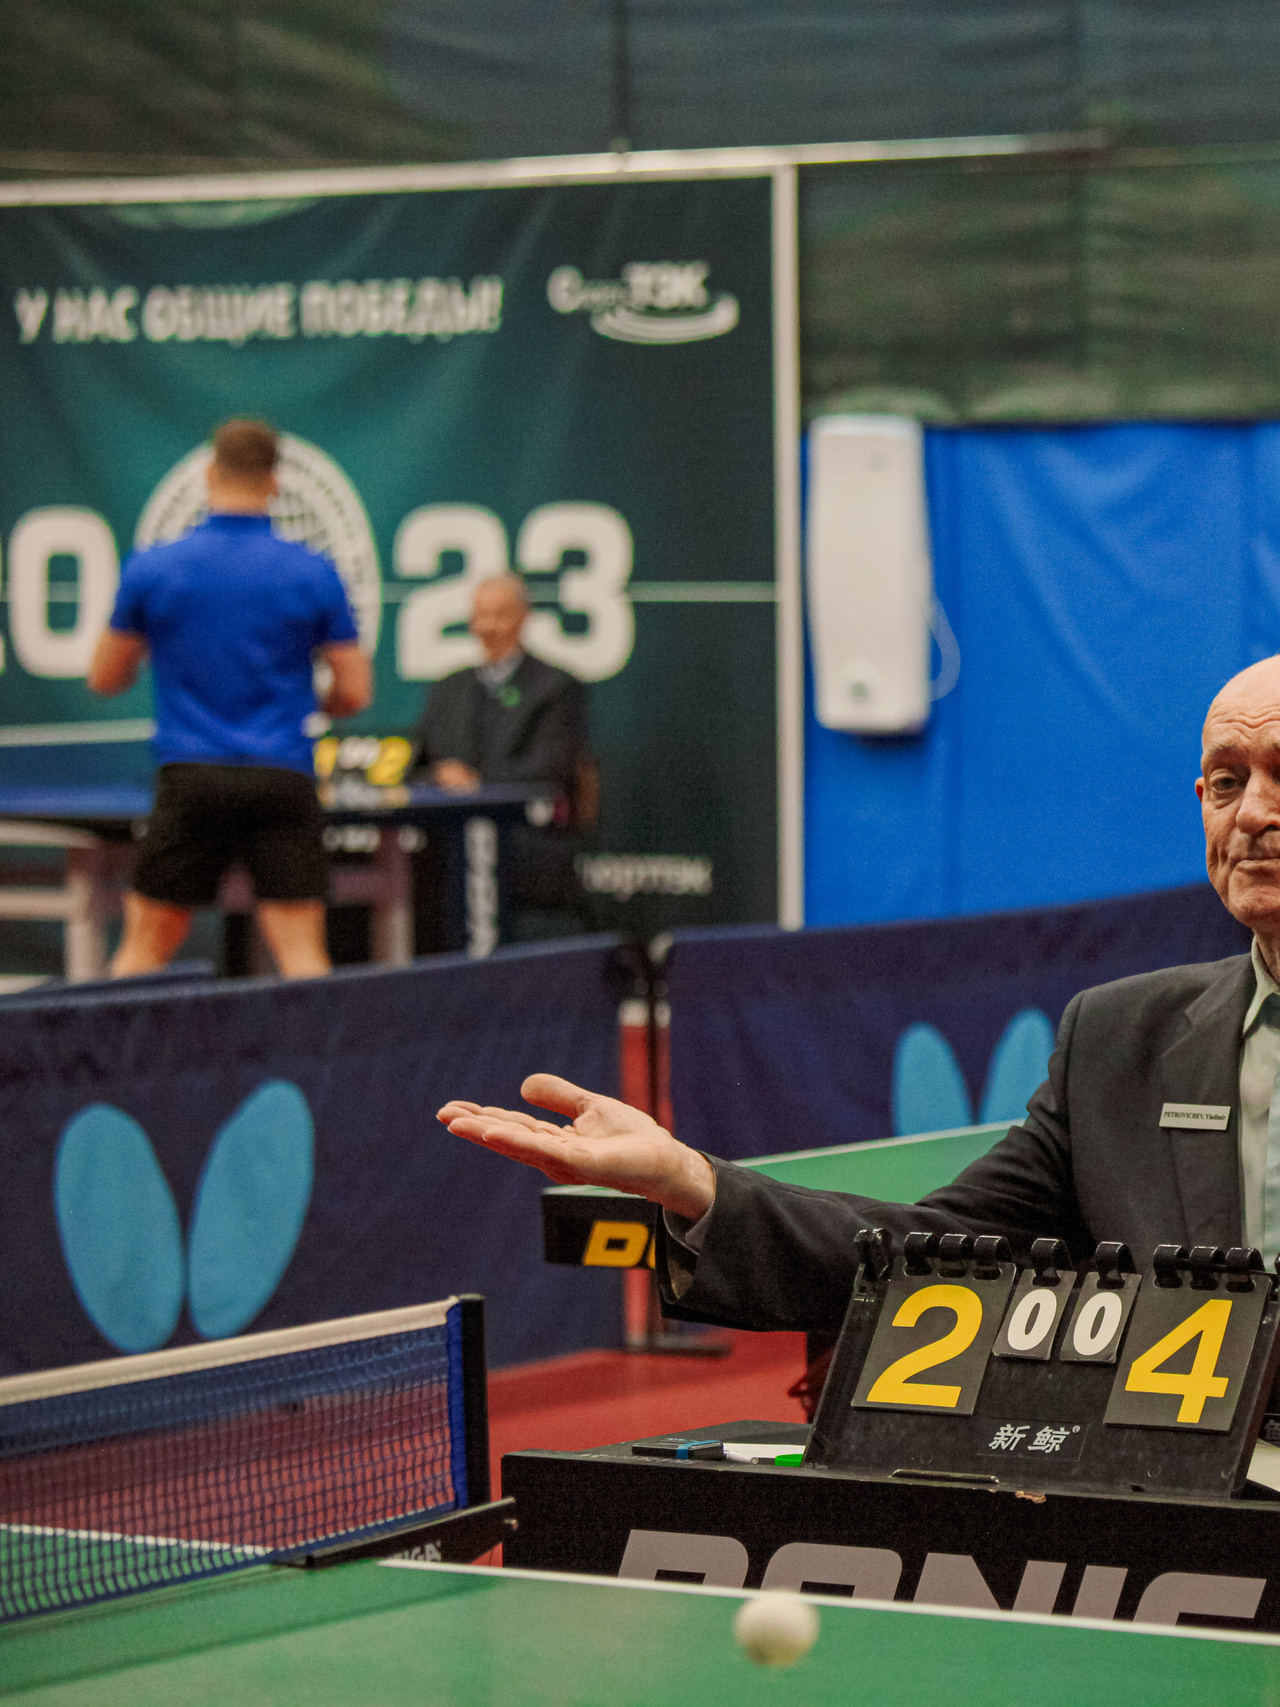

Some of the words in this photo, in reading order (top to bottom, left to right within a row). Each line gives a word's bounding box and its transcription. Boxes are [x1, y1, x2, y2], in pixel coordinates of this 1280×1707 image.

[16, 288, 48, 343] У
[53, 286, 138, 343] НАС
[143, 284, 295, 346] ОБЩИЕ
[302, 275, 504, 343] ПОБЕДЫ!
[393, 503, 635, 682] 23
[867, 1284, 983, 1408] 2
[1007, 1288, 1057, 1351] 0
[1073, 1291, 1122, 1356] 0
[1125, 1299, 1233, 1423] 4
